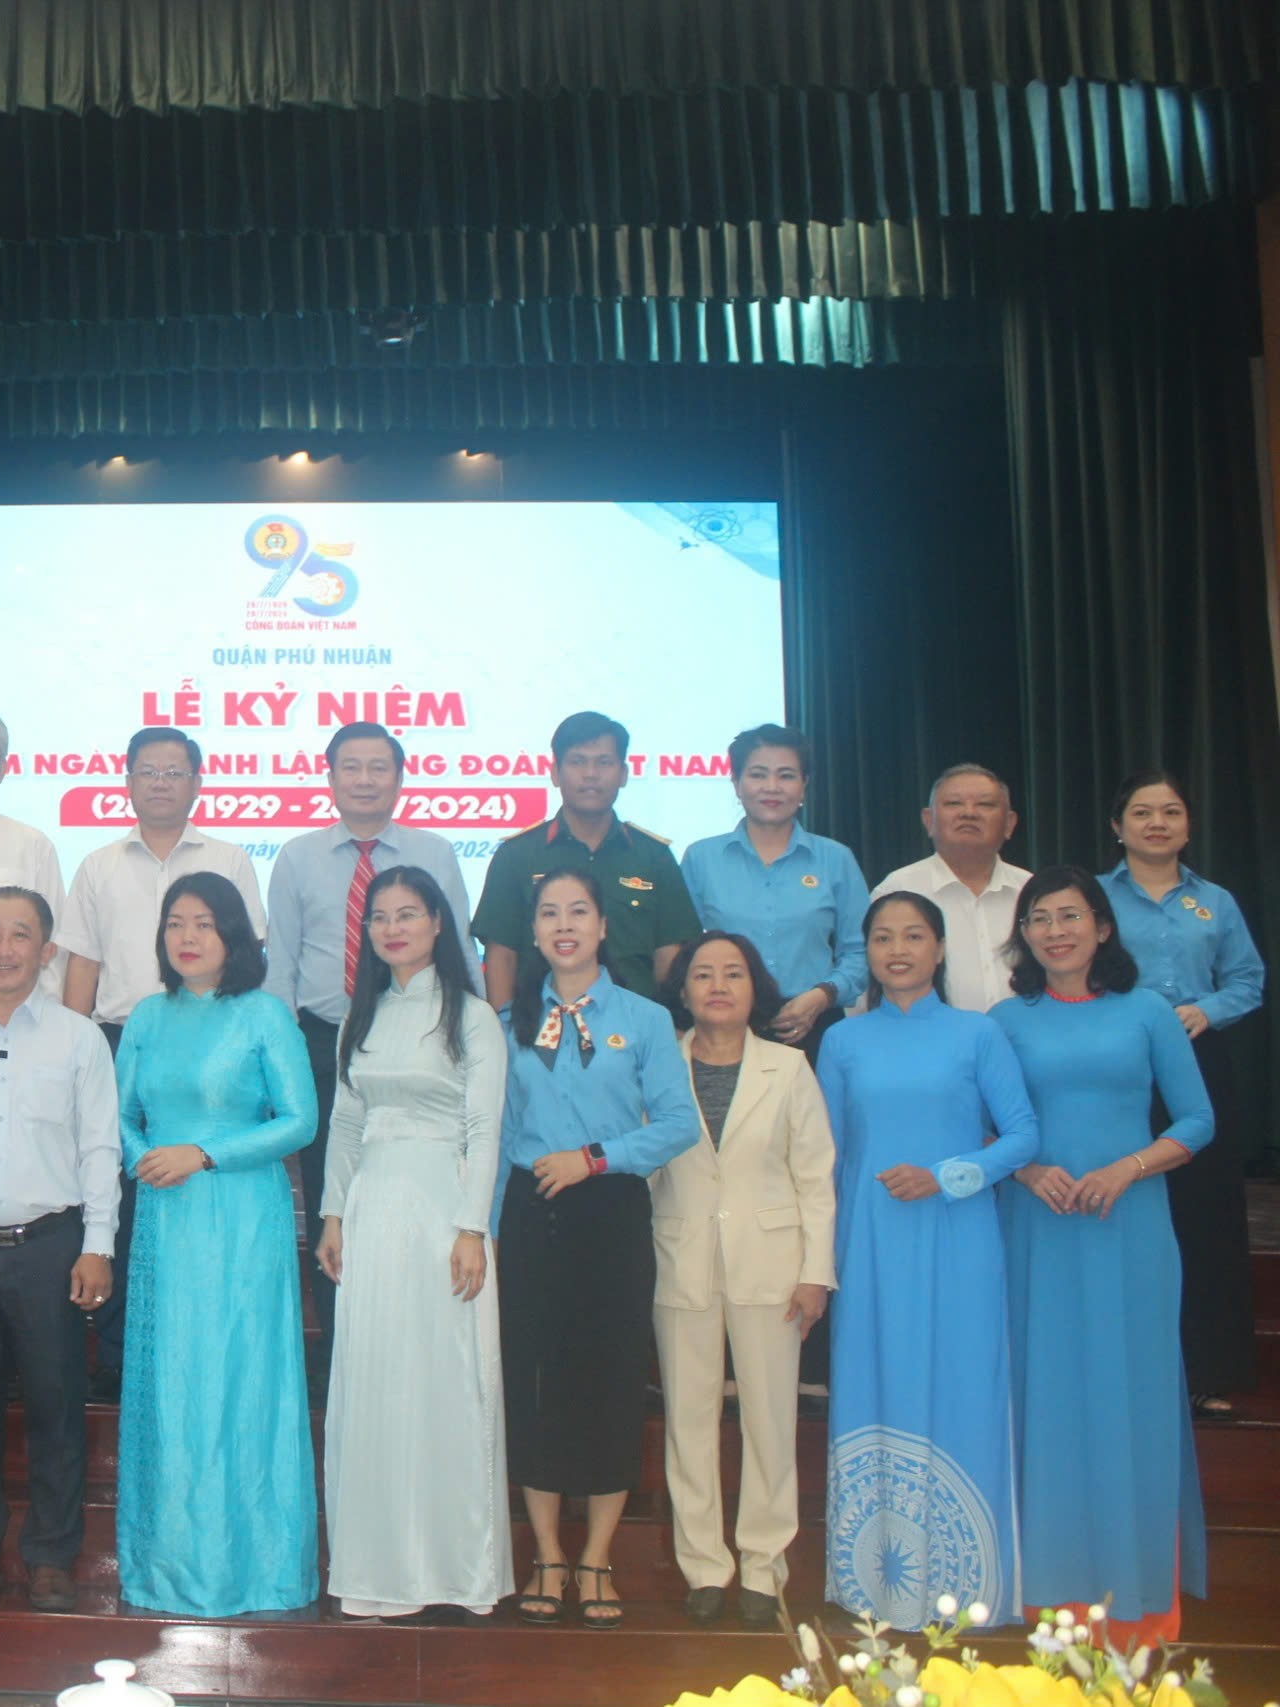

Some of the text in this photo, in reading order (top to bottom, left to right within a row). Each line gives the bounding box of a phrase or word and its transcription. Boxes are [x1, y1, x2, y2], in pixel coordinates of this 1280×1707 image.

[333, 621, 358, 631] NAM
[212, 643, 393, 669] QUẬN PHÚ NHUẬN
[142, 678, 467, 737] LỄ KỶ NIỆM
[34, 748, 128, 775] NGÀY
[272, 749, 332, 781] LẬP
[659, 754, 731, 776] NAM
